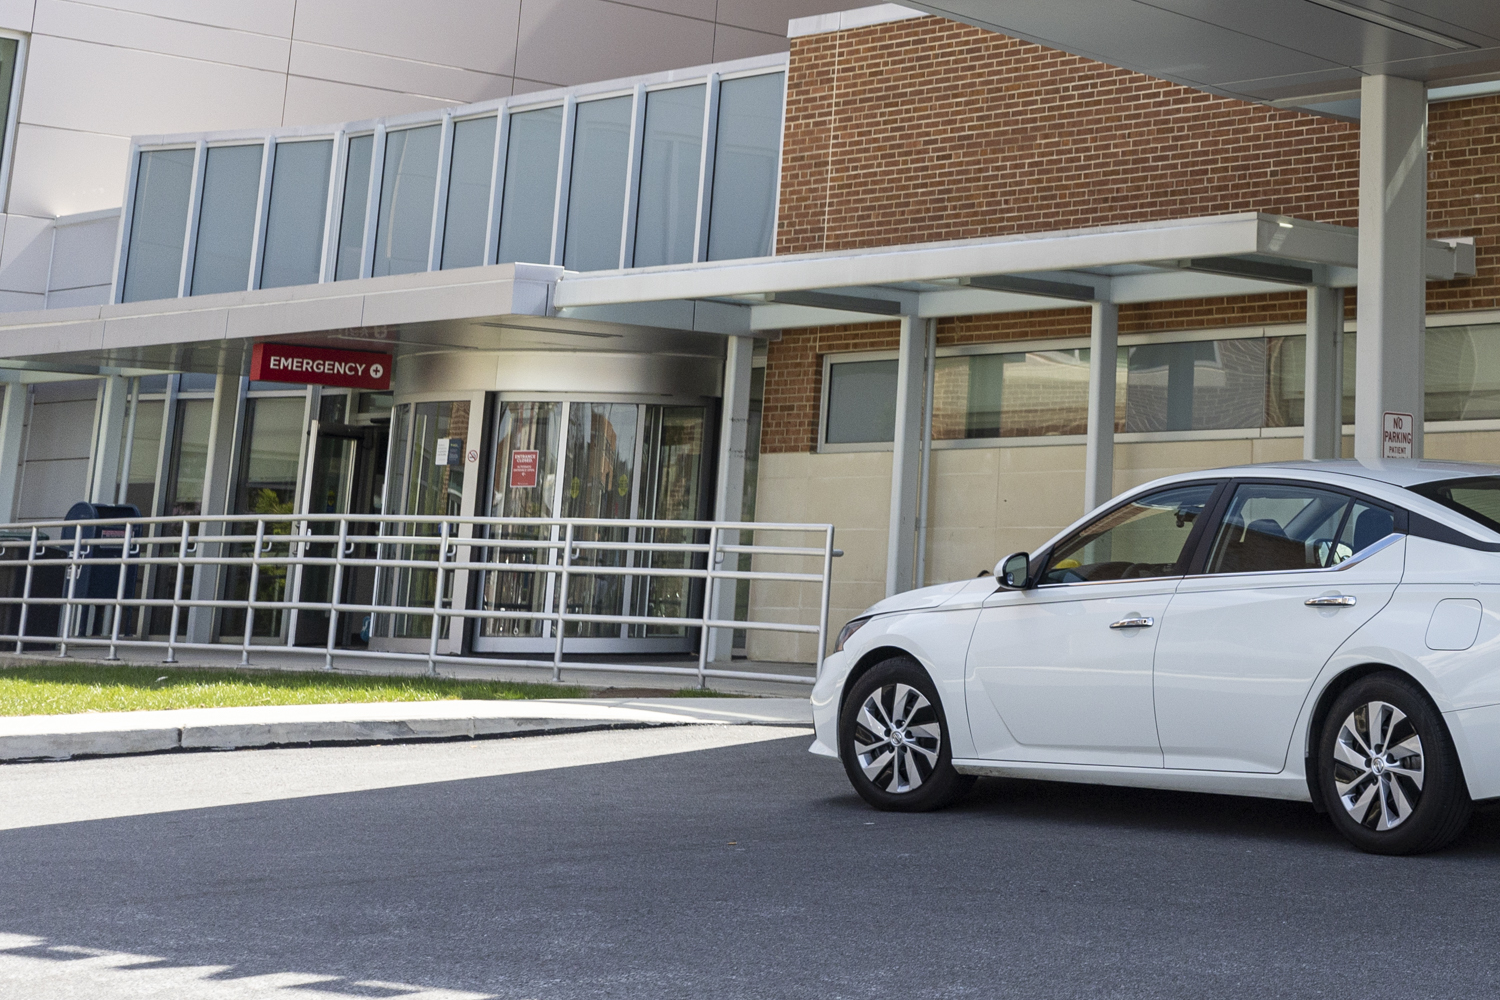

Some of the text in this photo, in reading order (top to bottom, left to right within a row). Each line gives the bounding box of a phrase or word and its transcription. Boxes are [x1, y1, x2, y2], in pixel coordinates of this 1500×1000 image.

[269, 355, 366, 376] EMERGENCY
[1393, 416, 1403, 430] NO
[1385, 431, 1413, 444] PARKING
[1389, 446, 1406, 454] PATIENT
